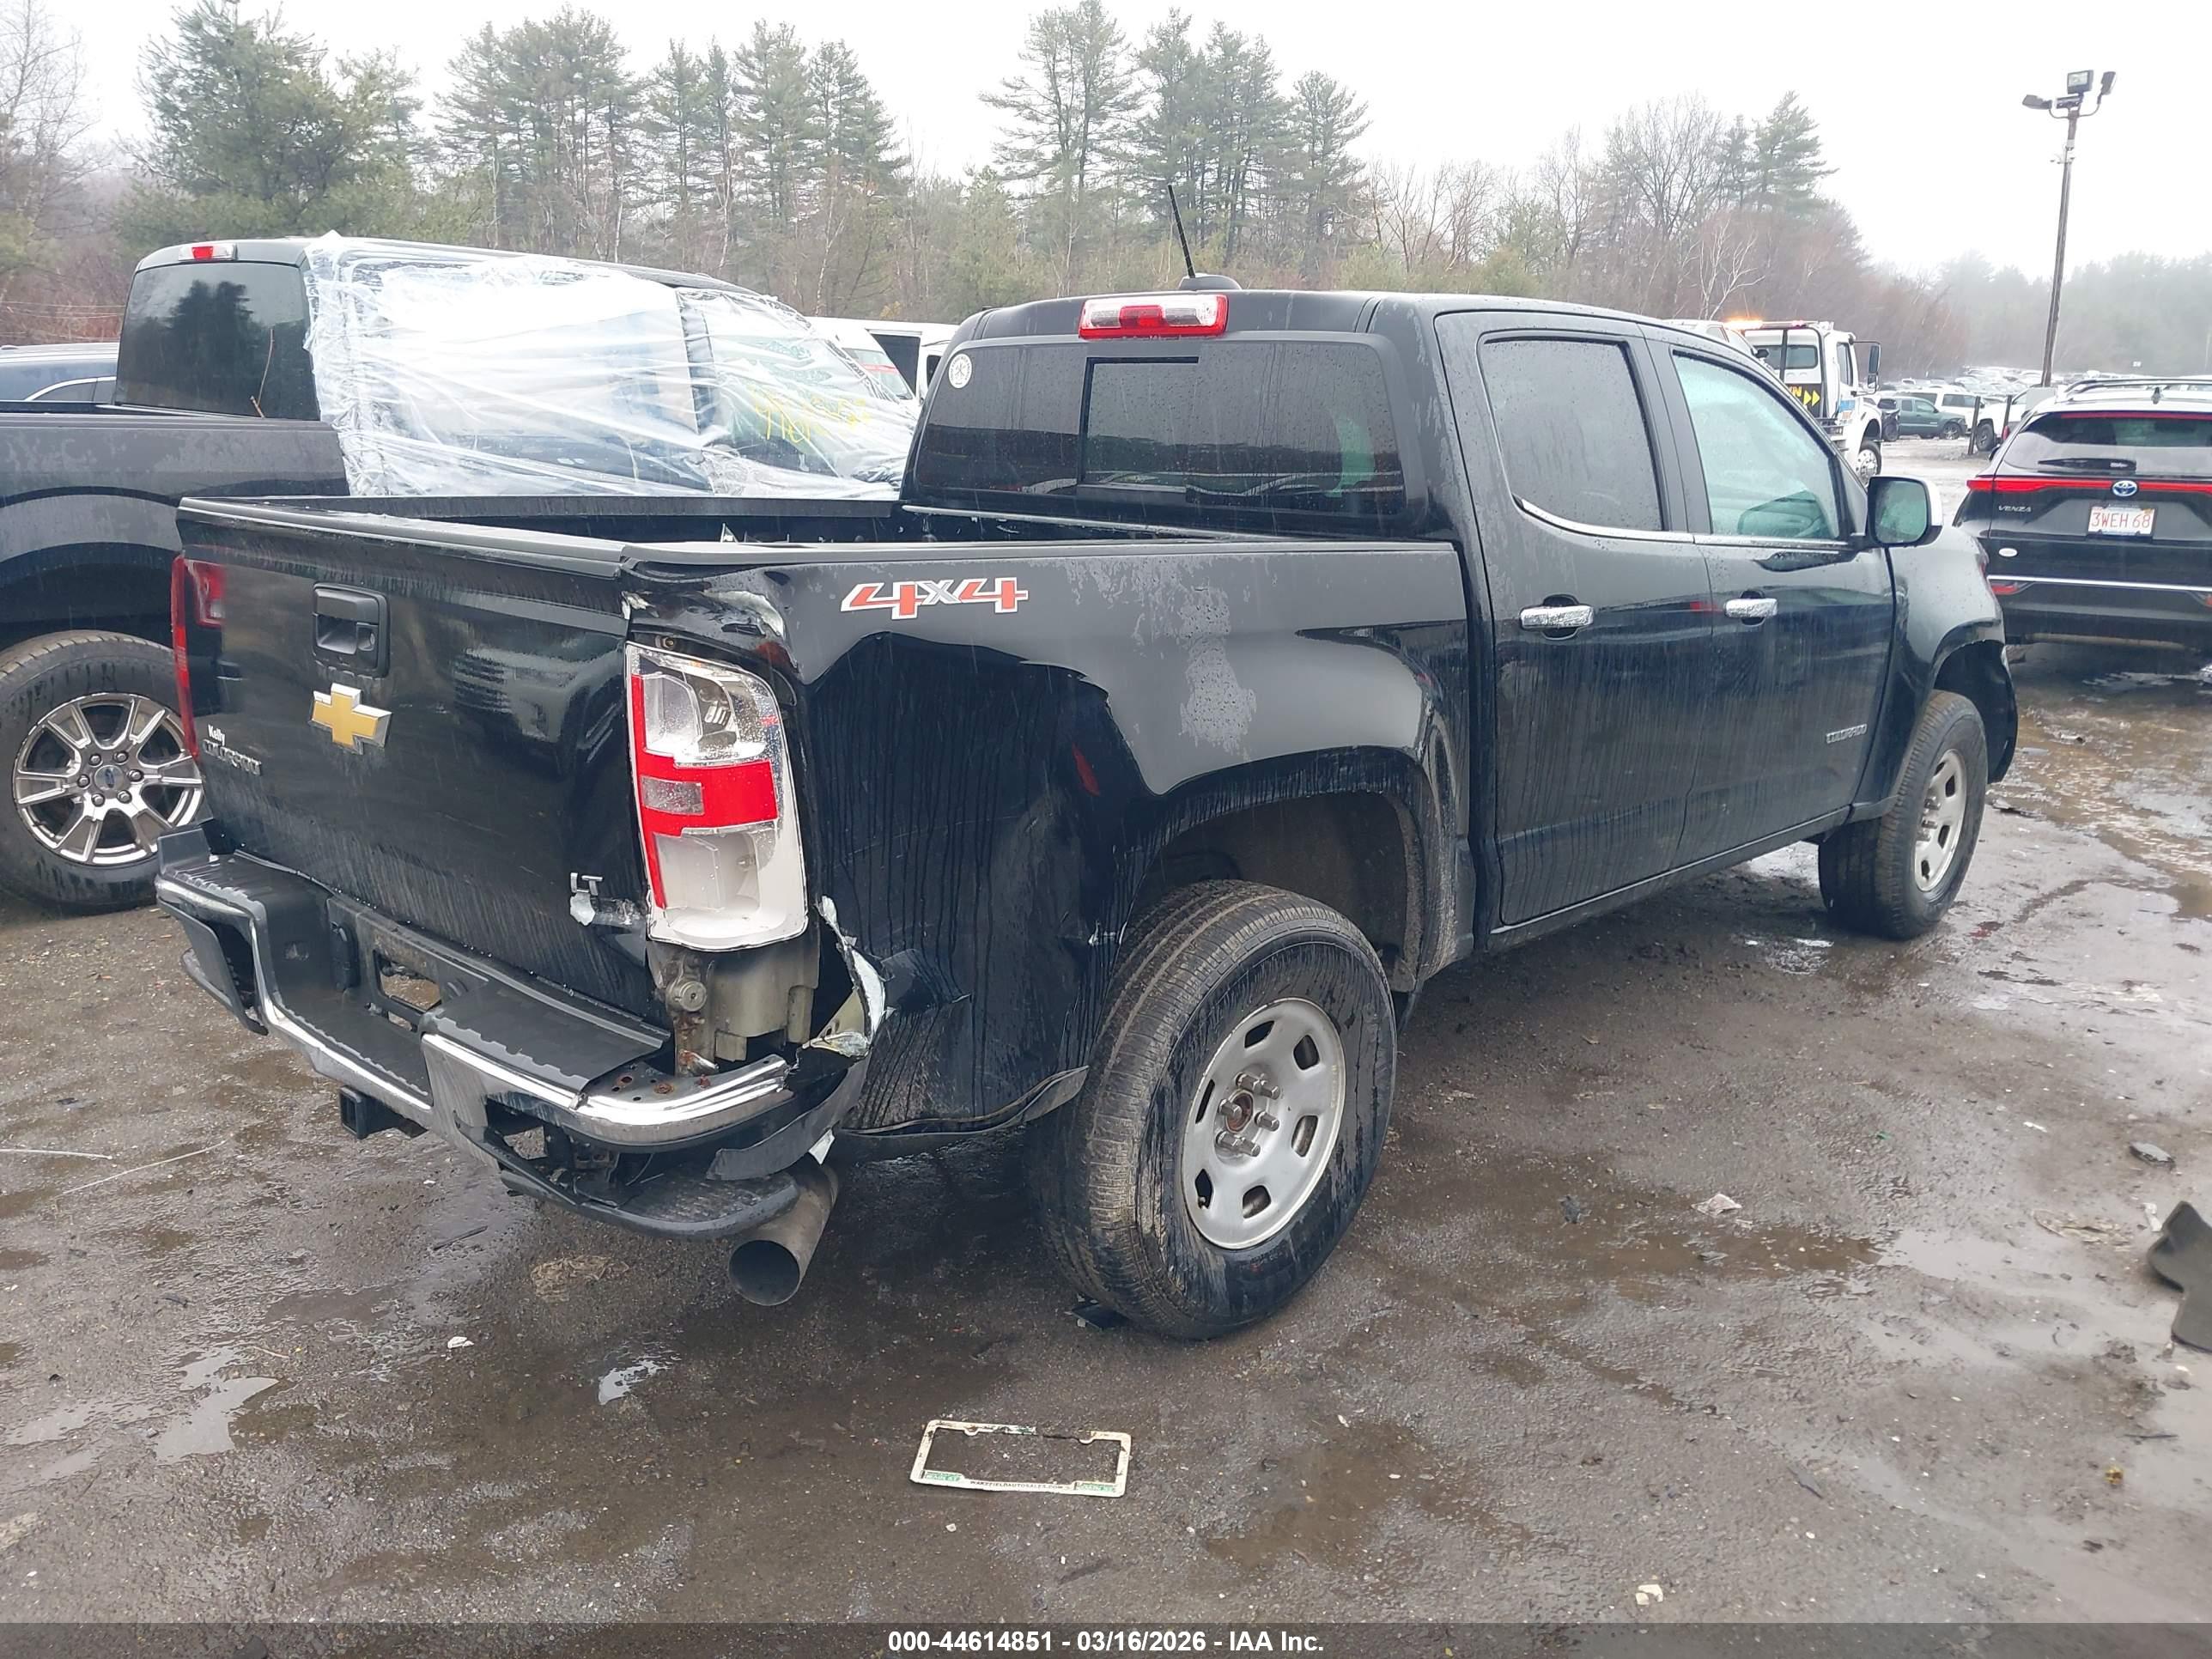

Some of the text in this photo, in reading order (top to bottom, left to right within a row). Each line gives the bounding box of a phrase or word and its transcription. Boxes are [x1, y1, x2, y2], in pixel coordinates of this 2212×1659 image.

[2091, 512, 2151, 529] 3WEH 68
[208, 724, 226, 747] Kelly
[570, 872, 604, 896] LT
